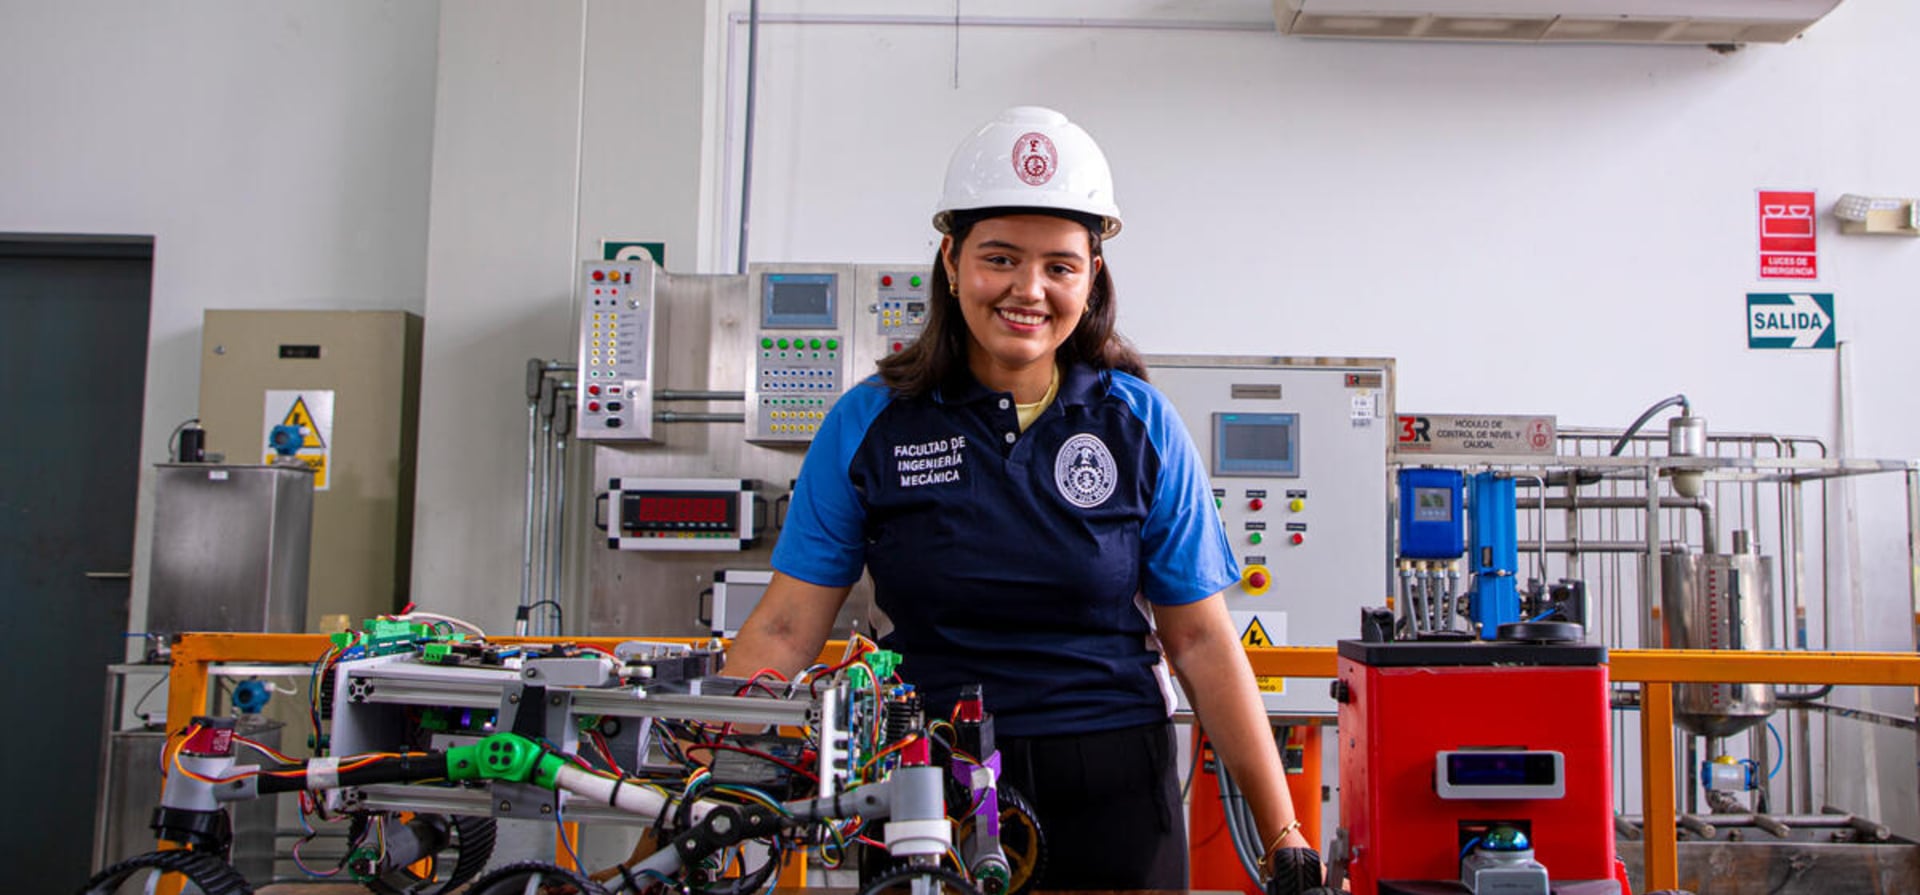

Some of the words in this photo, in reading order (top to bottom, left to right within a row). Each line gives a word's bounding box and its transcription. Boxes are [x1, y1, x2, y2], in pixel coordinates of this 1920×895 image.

[1754, 312, 1822, 329] SALIDA
[1398, 416, 1431, 442] 3R
[1491, 421, 1503, 429] DE
[1437, 430, 1474, 439] CONTROL
[1477, 431, 1488, 439] DE
[1490, 431, 1512, 439] NIVEL
[894, 440, 947, 457] FACULTAD
[950, 436, 965, 449] DE
[1463, 440, 1494, 449] CAUDAL
[898, 450, 962, 471] INGENIERÍA
[901, 469, 959, 487] MECÁNICA
